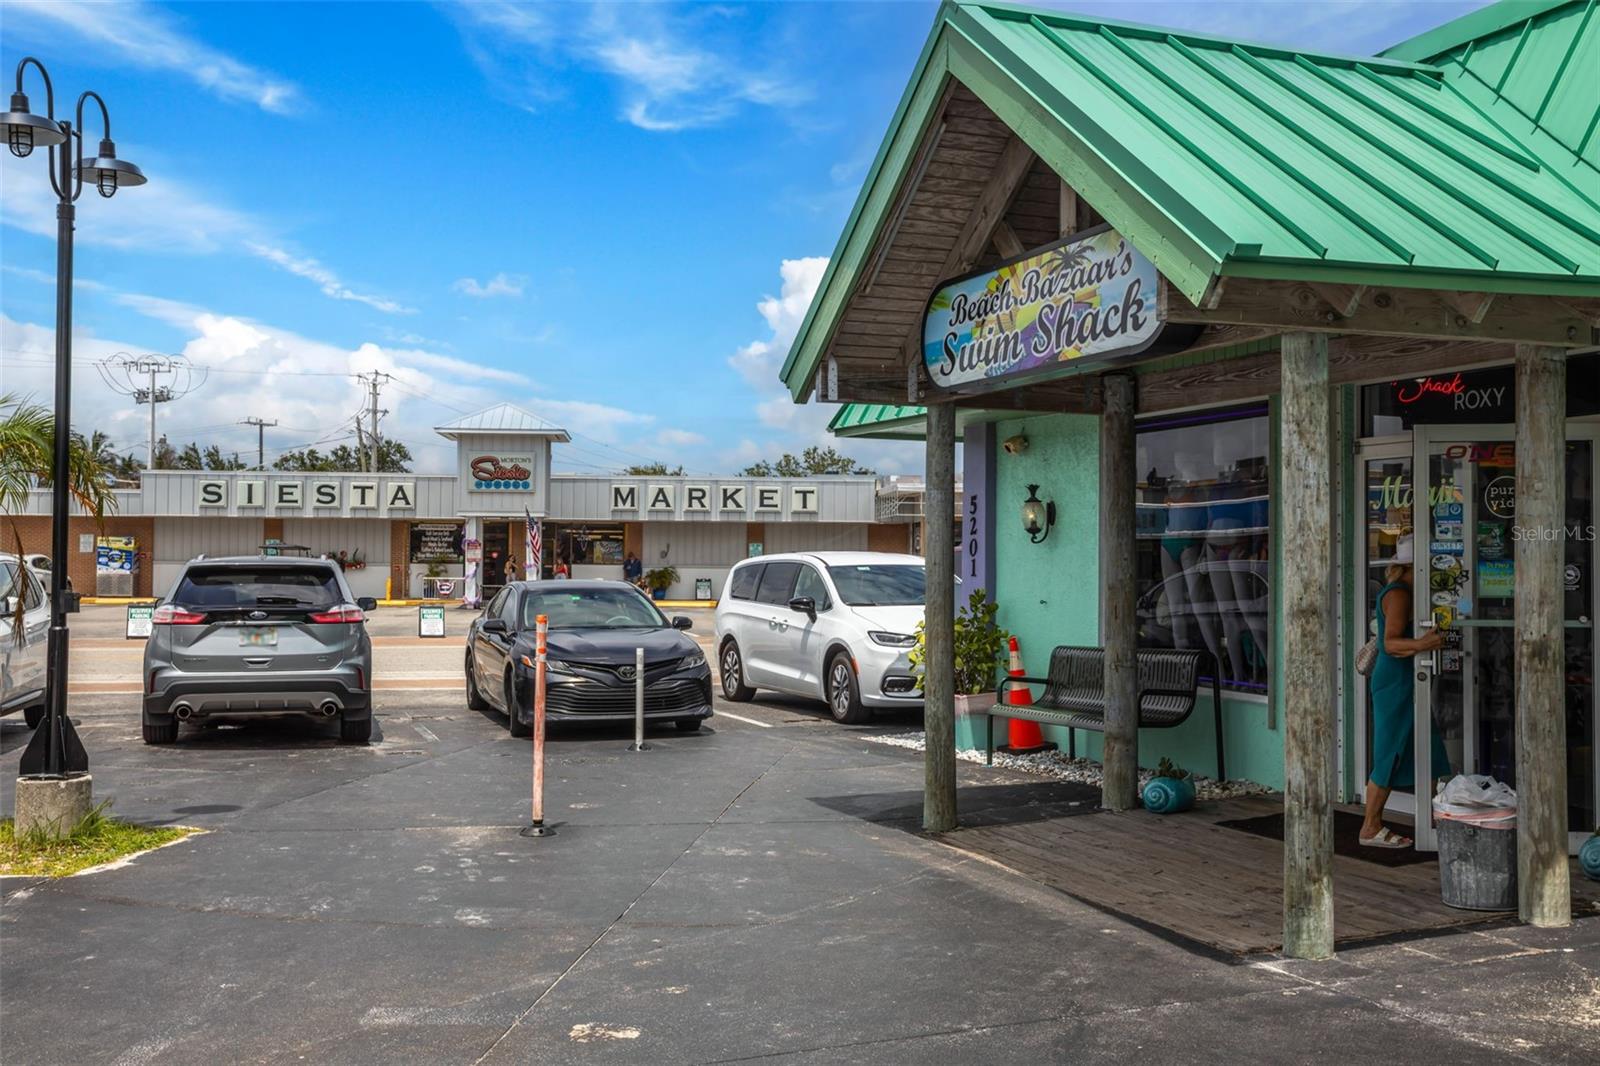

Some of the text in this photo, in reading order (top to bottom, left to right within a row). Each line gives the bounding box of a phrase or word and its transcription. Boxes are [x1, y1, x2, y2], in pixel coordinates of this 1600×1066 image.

[949, 240, 1133, 327] Beach Bazaar's
[940, 278, 1147, 376] Swim Shack
[1454, 386, 1505, 411] ROXY
[202, 483, 411, 506] SIESTA
[613, 487, 815, 509] MARKET
[1490, 486, 1515, 497] pur
[1490, 498, 1515, 511] vid
[969, 494, 979, 577] 5201
